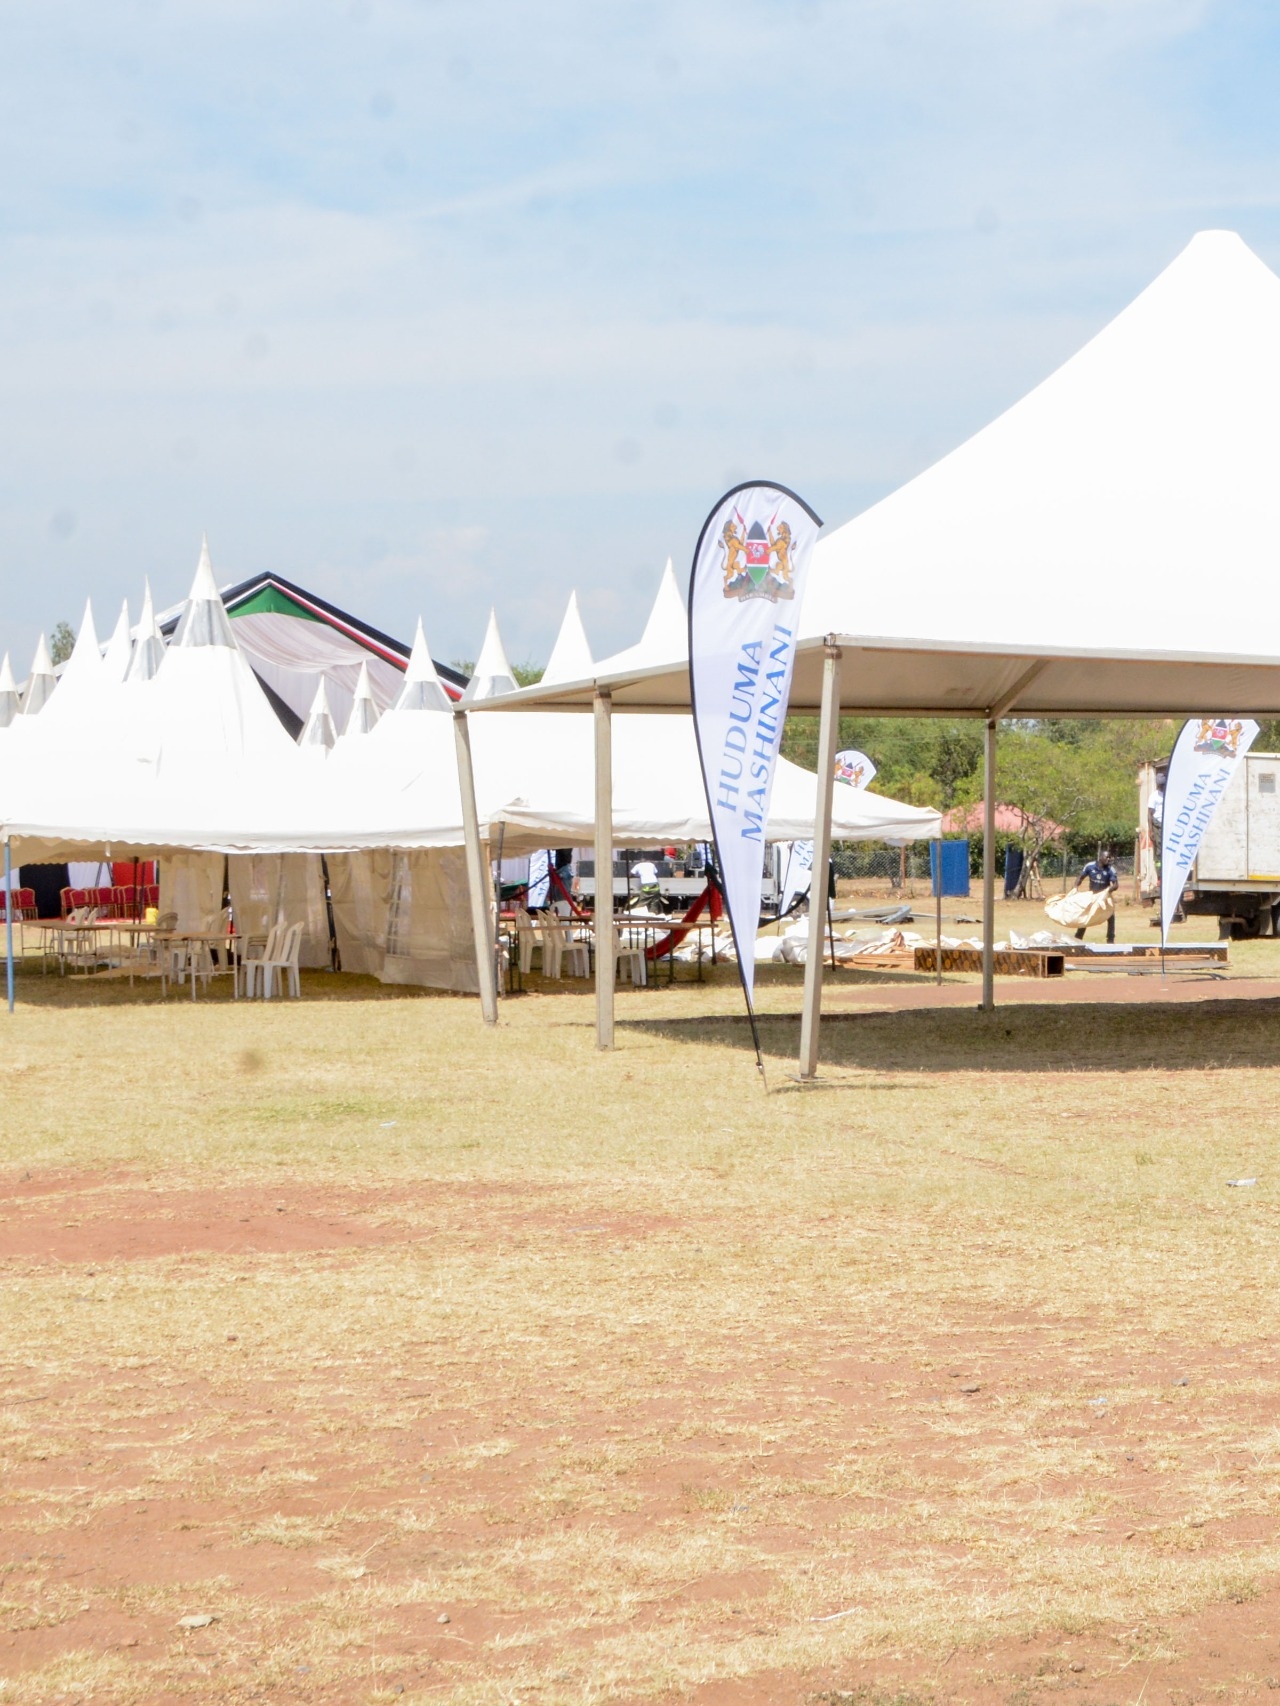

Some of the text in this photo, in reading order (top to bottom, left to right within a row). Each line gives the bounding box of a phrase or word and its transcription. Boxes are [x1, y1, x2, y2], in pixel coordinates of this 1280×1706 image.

[717, 640, 763, 813] HUDUMA
[741, 624, 792, 843] MASHINANI
[1165, 773, 1211, 854] HUDUMA
[1176, 768, 1231, 870] MASHINANI
